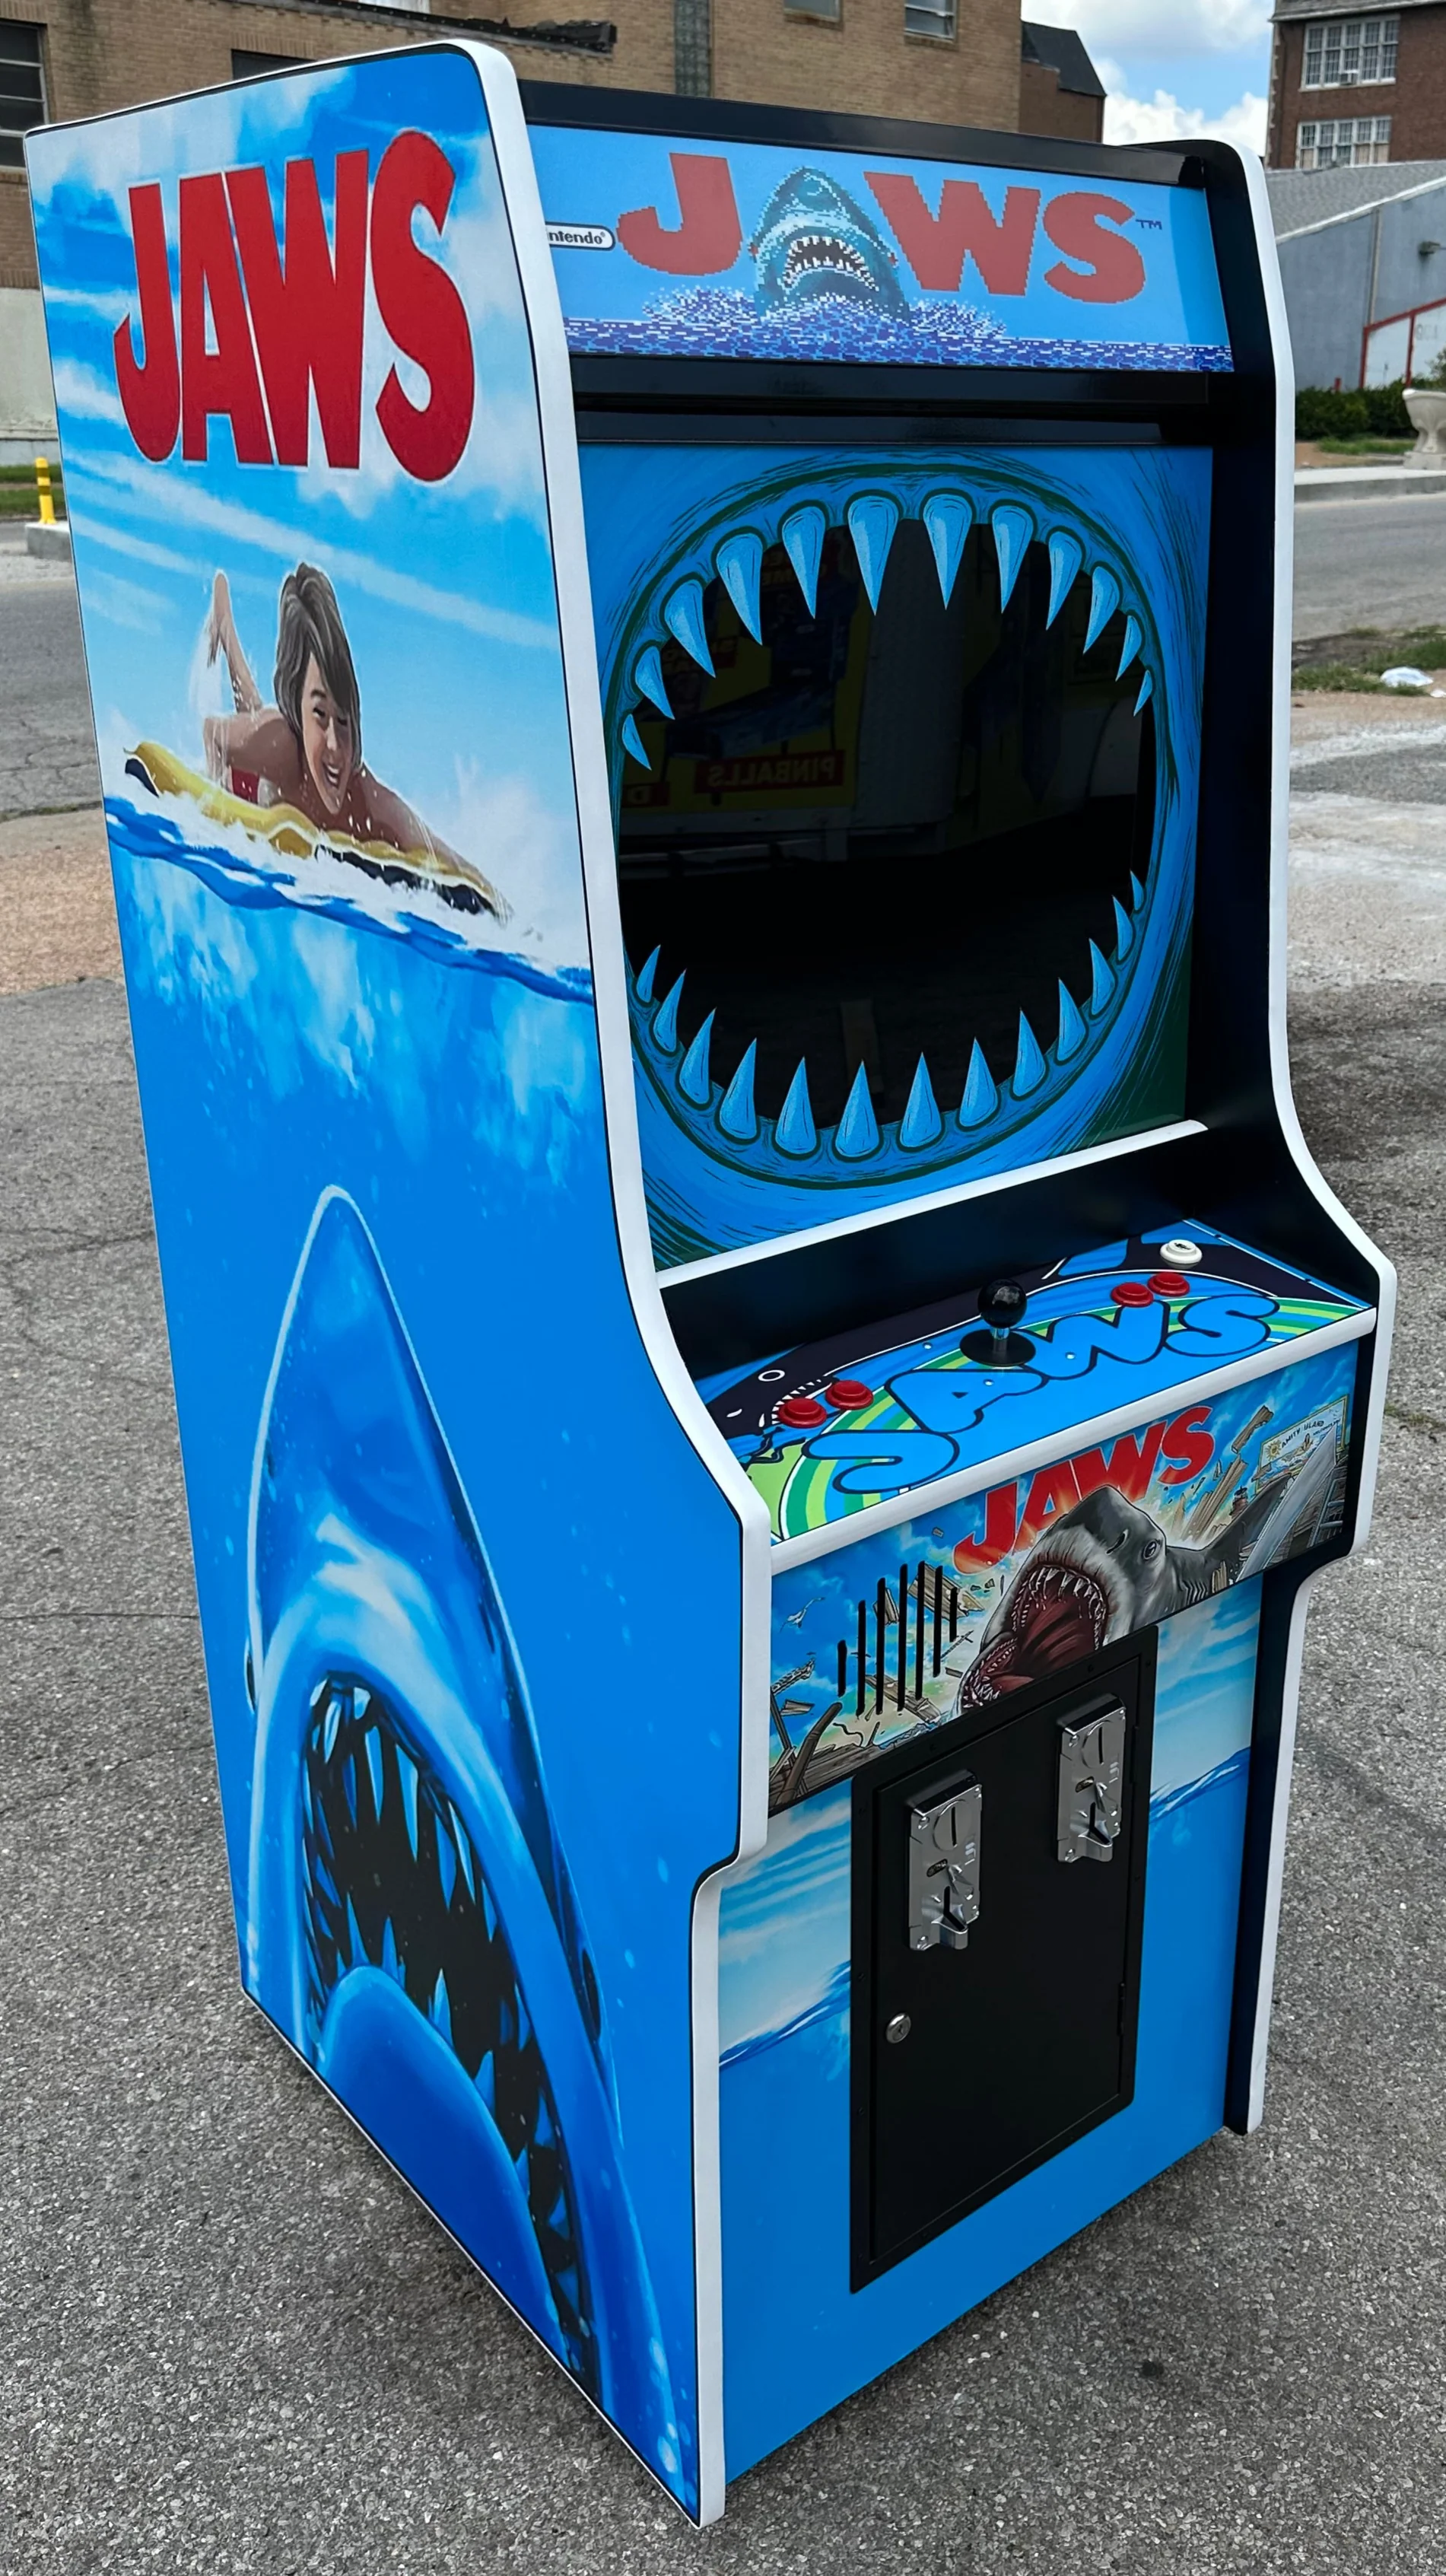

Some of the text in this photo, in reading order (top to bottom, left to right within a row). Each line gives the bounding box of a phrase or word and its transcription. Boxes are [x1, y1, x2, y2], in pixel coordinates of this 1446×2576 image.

[114, 130, 475, 482] JAWS
[801, 1294, 1280, 1494] JAWS
[953, 1405, 1216, 1576] JAWS
